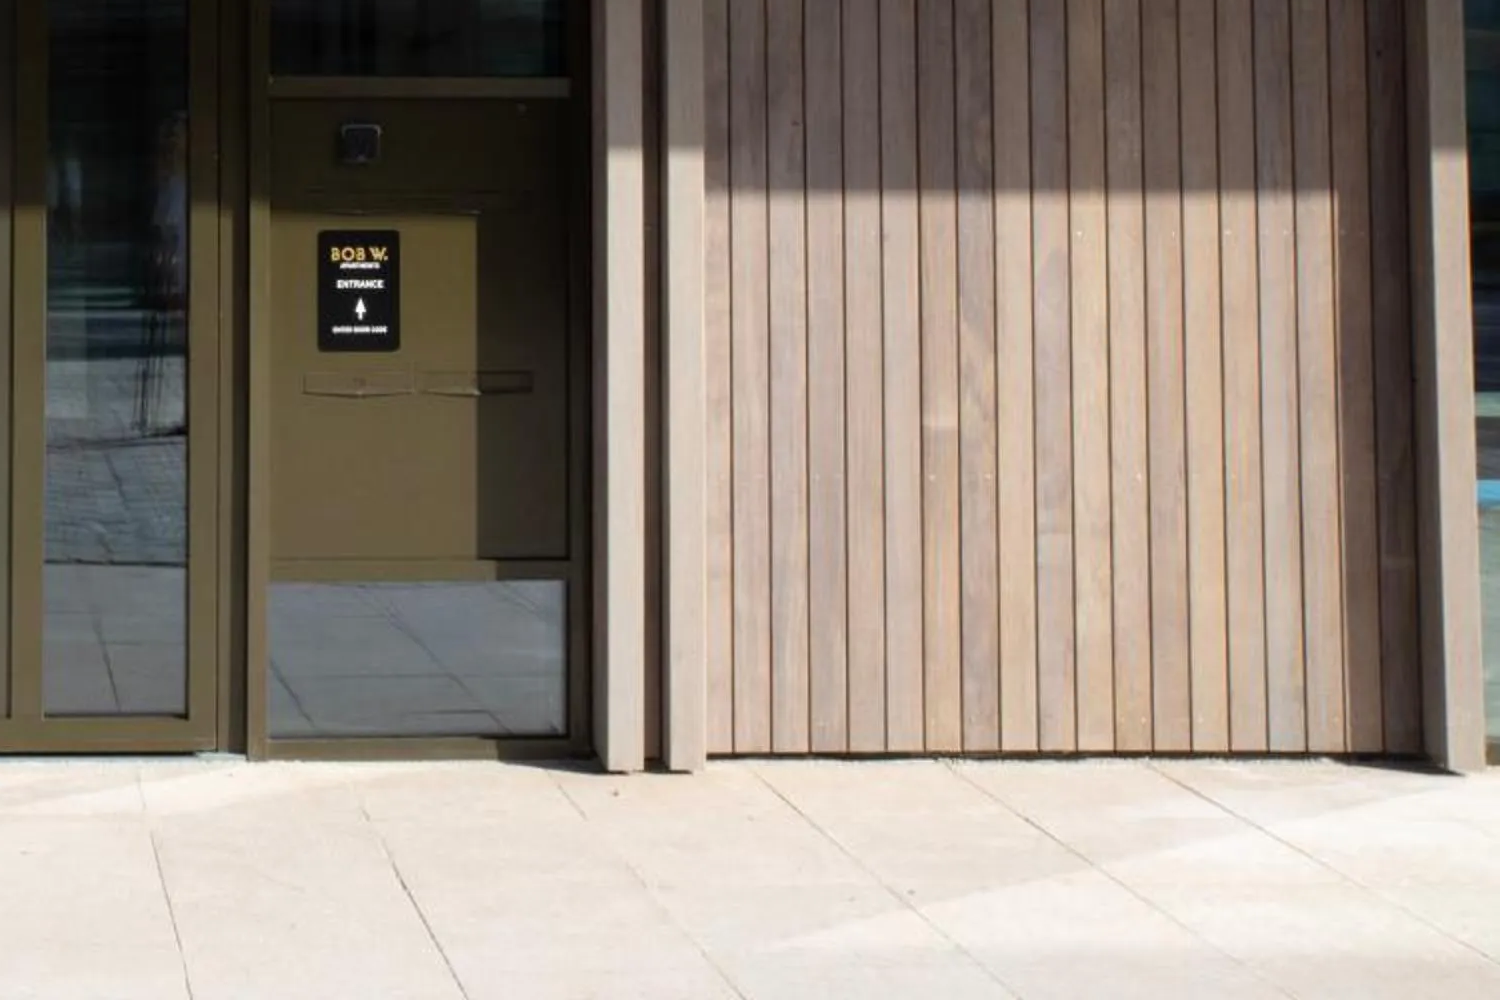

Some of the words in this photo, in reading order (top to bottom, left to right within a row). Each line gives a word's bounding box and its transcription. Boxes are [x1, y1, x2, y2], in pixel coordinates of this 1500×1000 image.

[331, 247, 366, 261] BOB
[369, 247, 389, 261] W.
[336, 279, 384, 289] ENTRANCE
